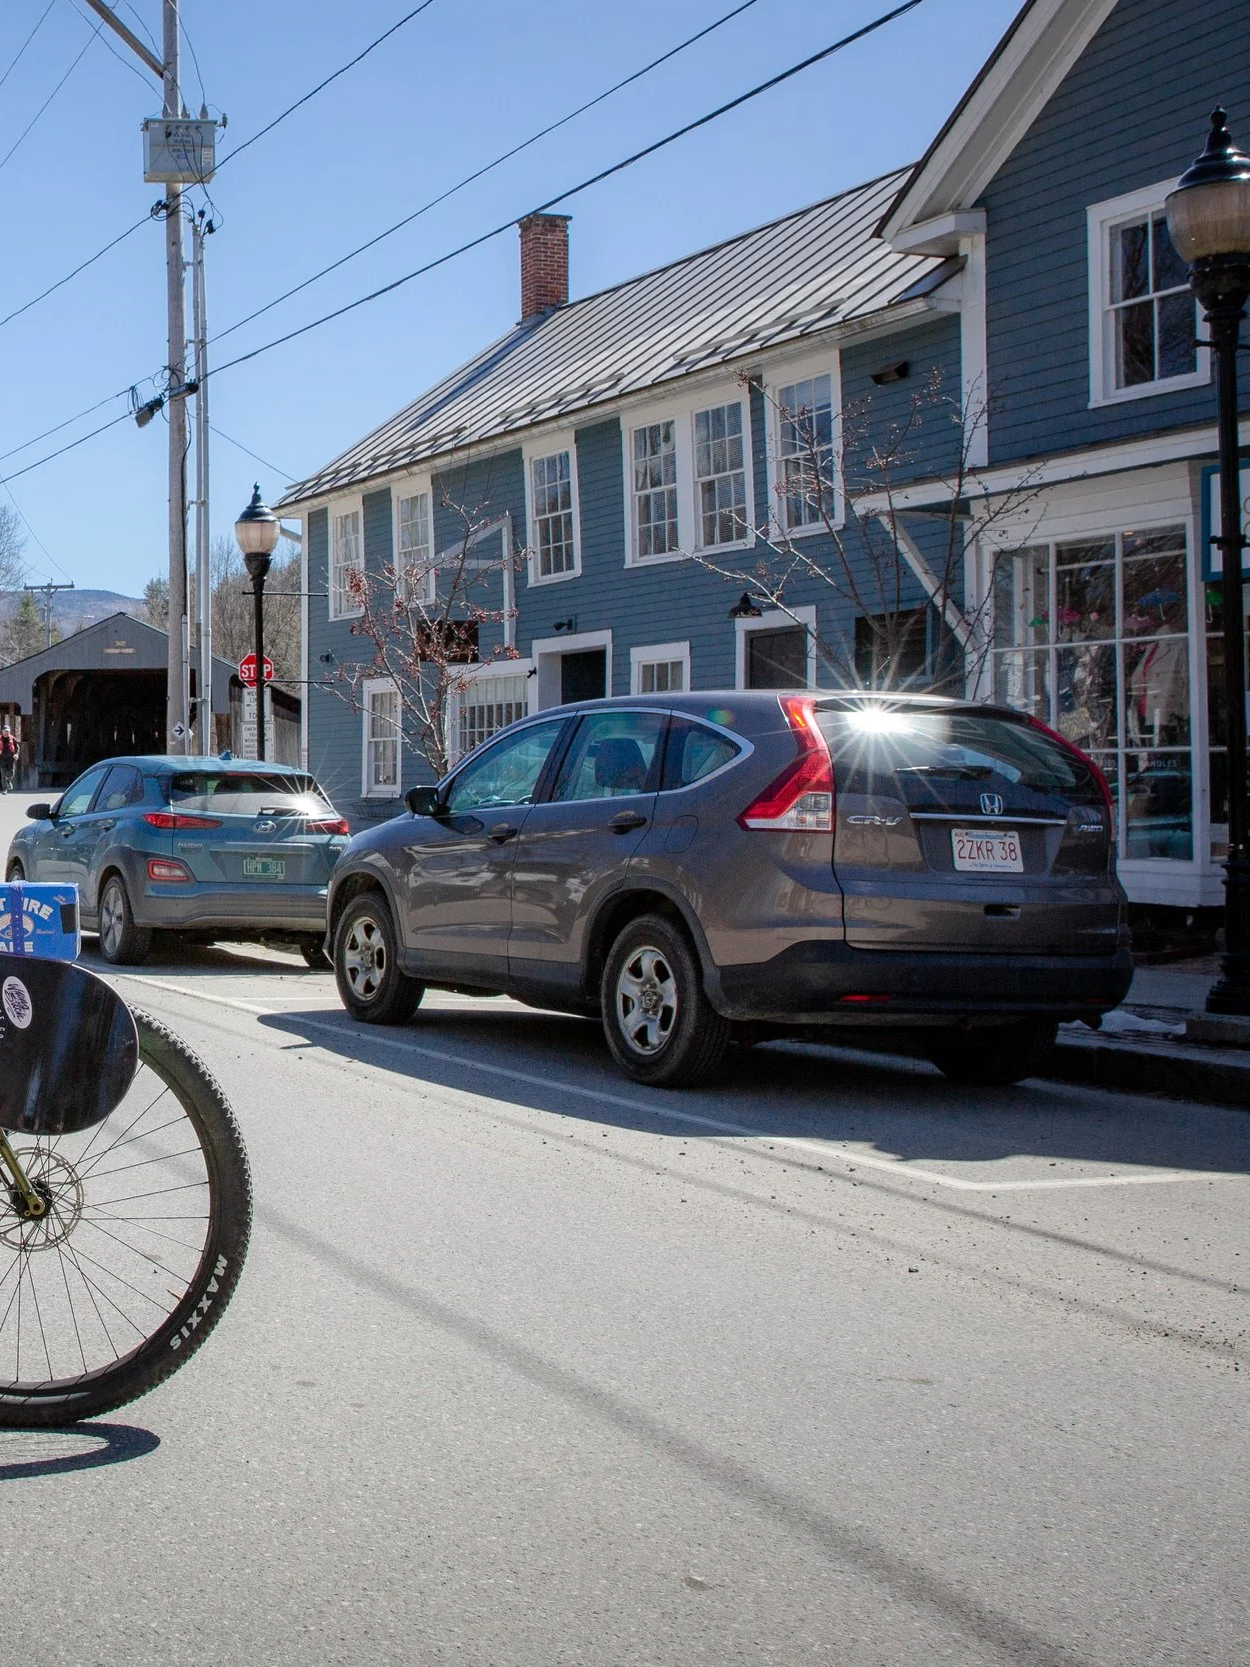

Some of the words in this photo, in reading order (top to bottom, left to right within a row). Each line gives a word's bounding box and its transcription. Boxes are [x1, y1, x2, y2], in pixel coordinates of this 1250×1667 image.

[241, 664, 272, 678] STP
[847, 815, 903, 826] CR-V
[957, 839, 995, 860] 2ZKR
[998, 841, 1018, 861] 38
[21, 897, 54, 921] IRE
[170, 1253, 228, 1350] MAXXIS
